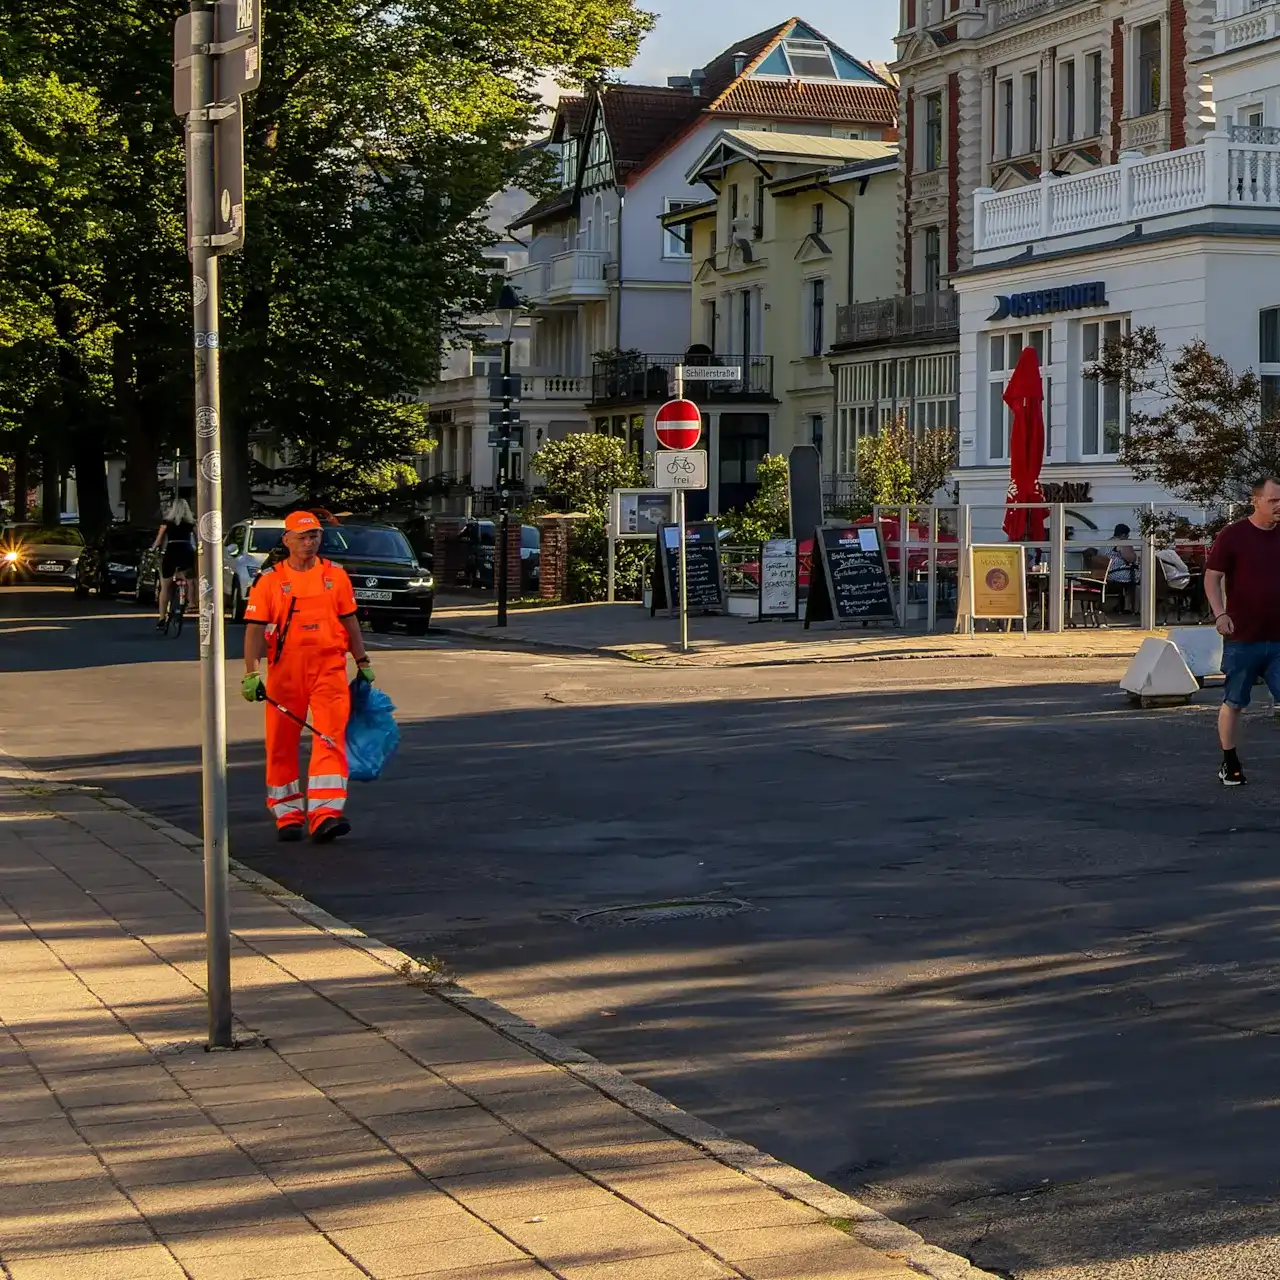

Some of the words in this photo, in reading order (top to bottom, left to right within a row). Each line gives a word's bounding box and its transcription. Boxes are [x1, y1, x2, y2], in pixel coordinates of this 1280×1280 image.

[1010, 281, 1110, 318] OSTSEEHOTEL
[685, 369, 735, 378] Schillerstraße
[673, 475, 690, 484] frei
